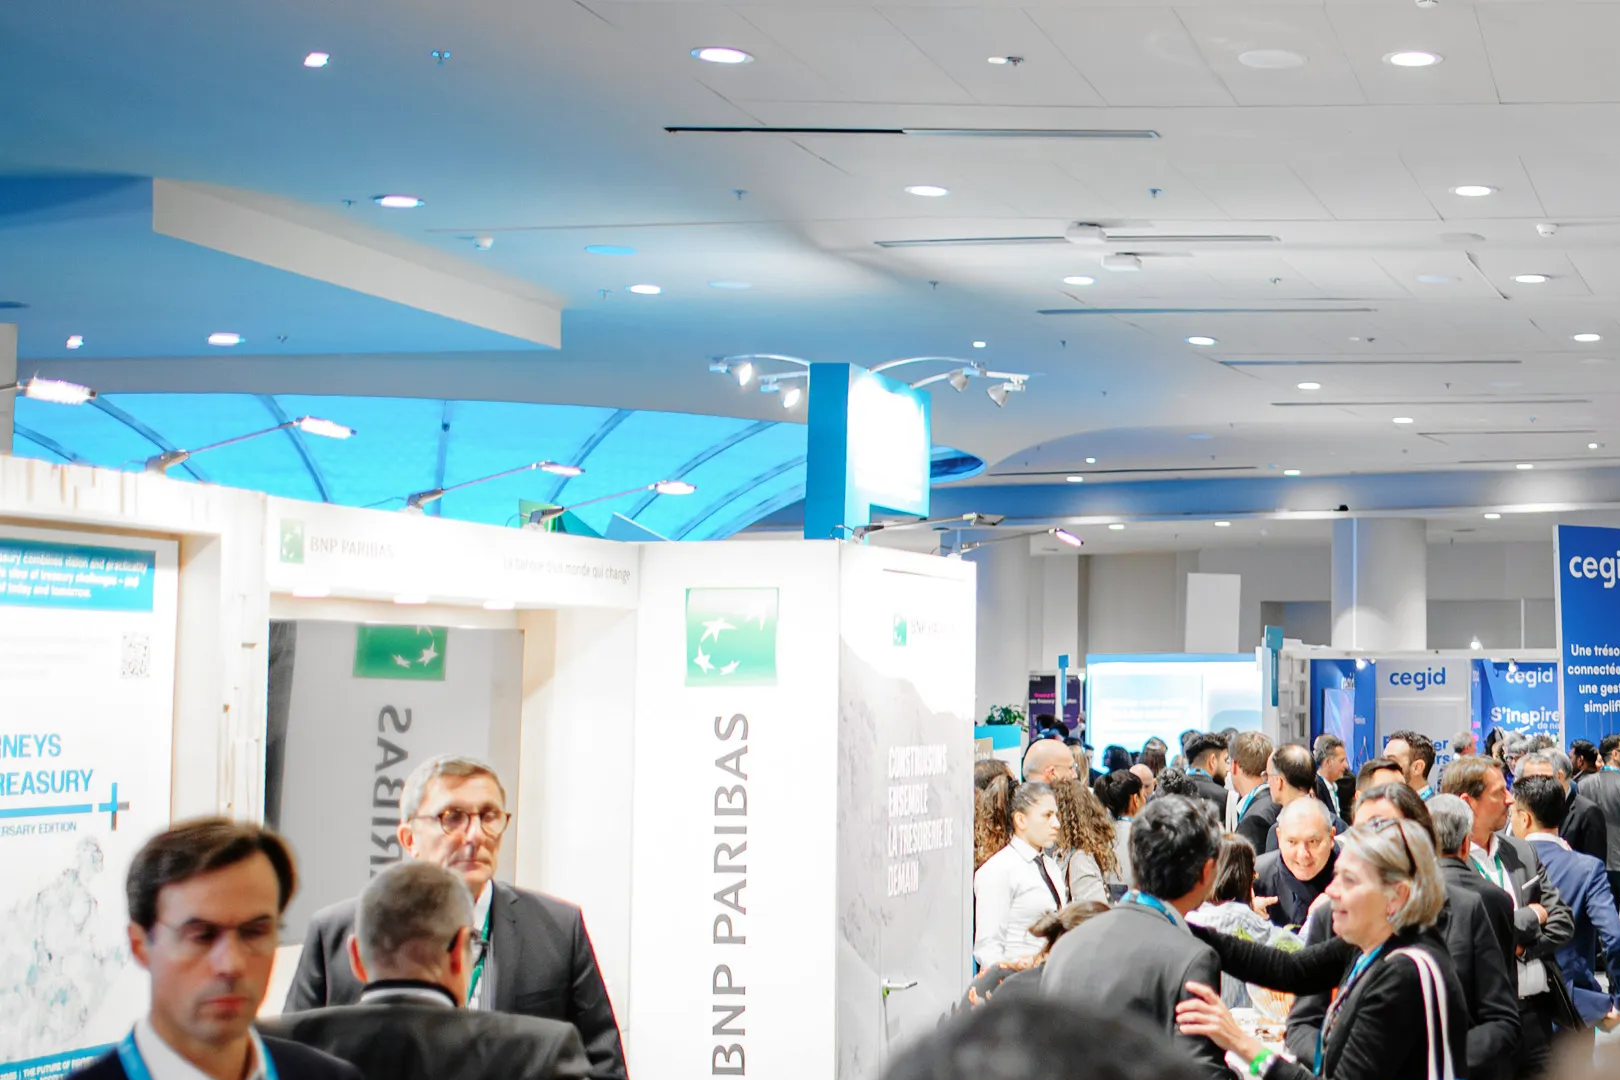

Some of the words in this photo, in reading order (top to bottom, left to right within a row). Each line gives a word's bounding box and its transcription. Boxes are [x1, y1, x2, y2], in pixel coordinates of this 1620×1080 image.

[310, 535, 338, 554] BNP
[90, 557, 104, 570] and
[565, 562, 590, 577] monde
[592, 563, 604, 580] qui
[605, 565, 630, 584] change
[1571, 644, 1592, 656] Une
[1389, 667, 1446, 691] cegid
[1505, 667, 1553, 688] cegid
[1579, 684, 1598, 694] une
[0, 733, 62, 758] NEYS
[888, 744, 947, 778] CONSTRUISONS
[888, 782, 928, 818] ENSEMBLE
[38, 821, 77, 833] EDITION
[713, 713, 749, 944] PARIBAS
[888, 824, 898, 857] LA
[898, 815, 944, 856] TRÉSORERIE
[944, 816, 954, 848] DE
[888, 860, 919, 897] DEMAIN
[712, 964, 746, 1076] BNP
